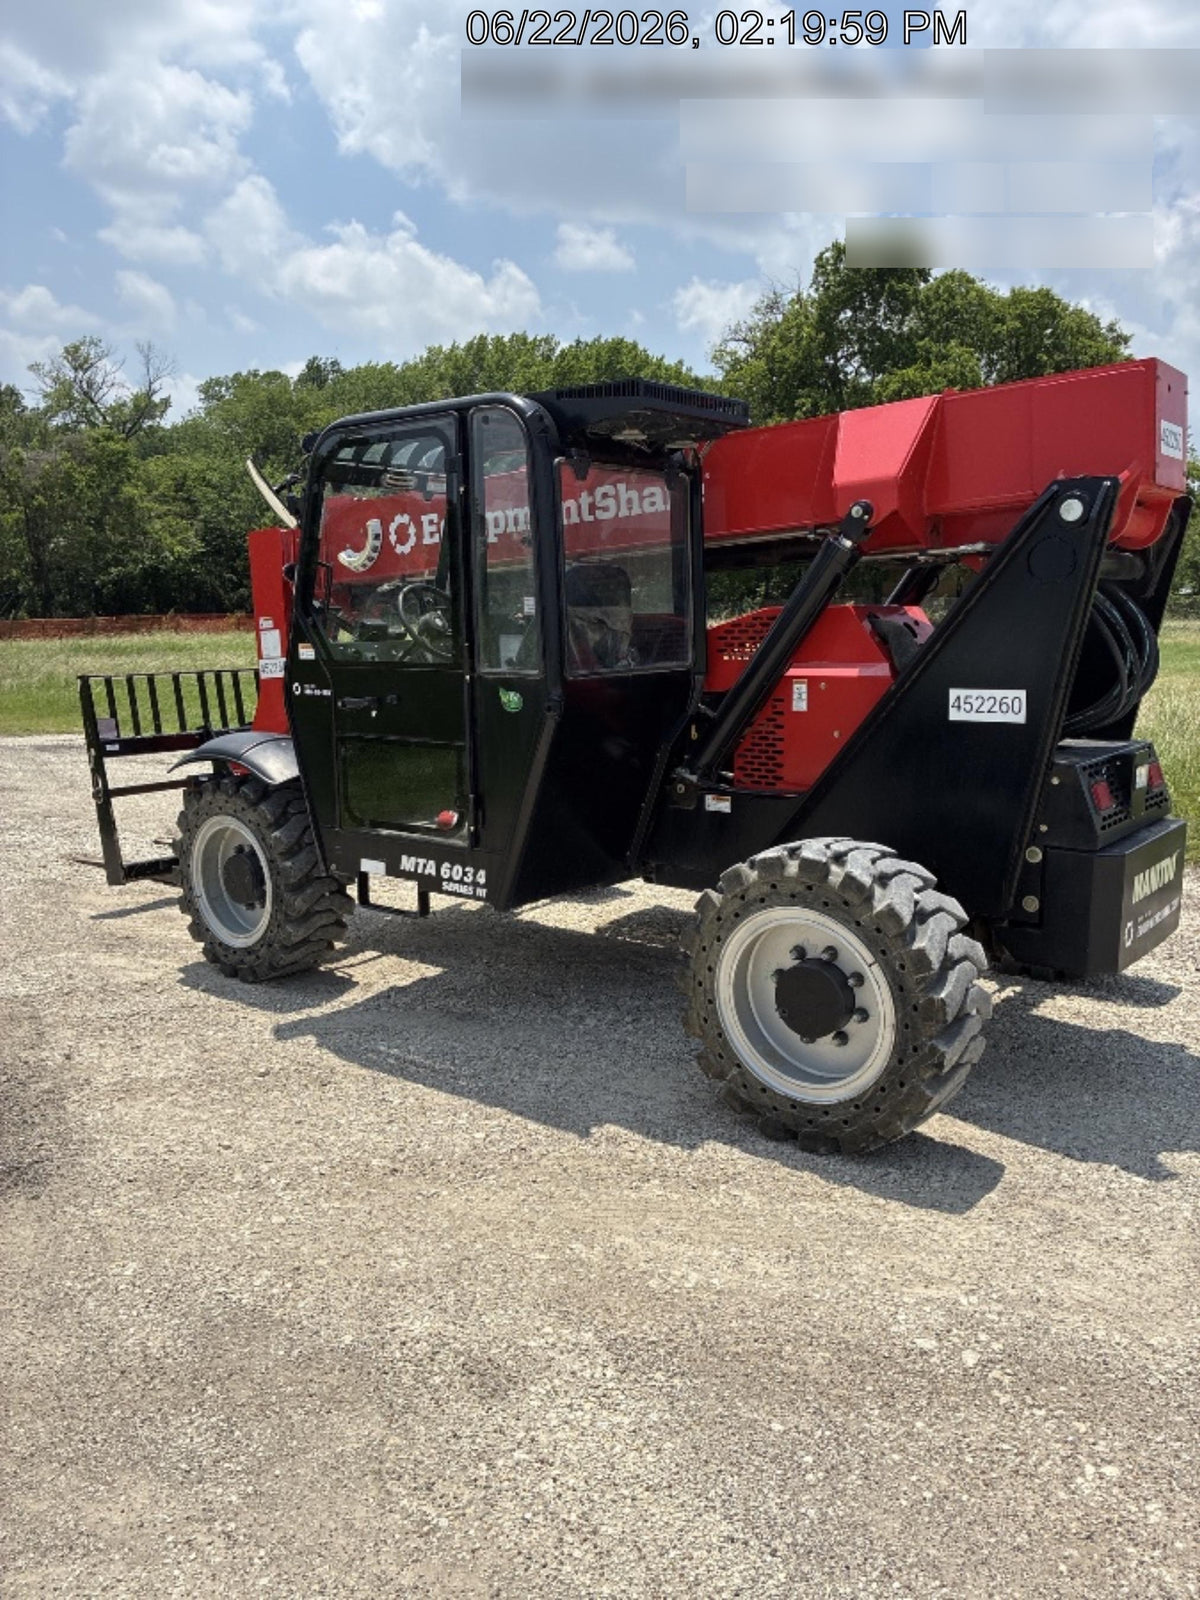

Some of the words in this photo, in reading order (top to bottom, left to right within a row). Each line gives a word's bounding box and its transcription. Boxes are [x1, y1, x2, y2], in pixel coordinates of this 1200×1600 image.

[950, 694, 1022, 715] 452260
[400, 855, 436, 877] MTA
[440, 862, 486, 885] 6034
[442, 881, 474, 895] SERIES
